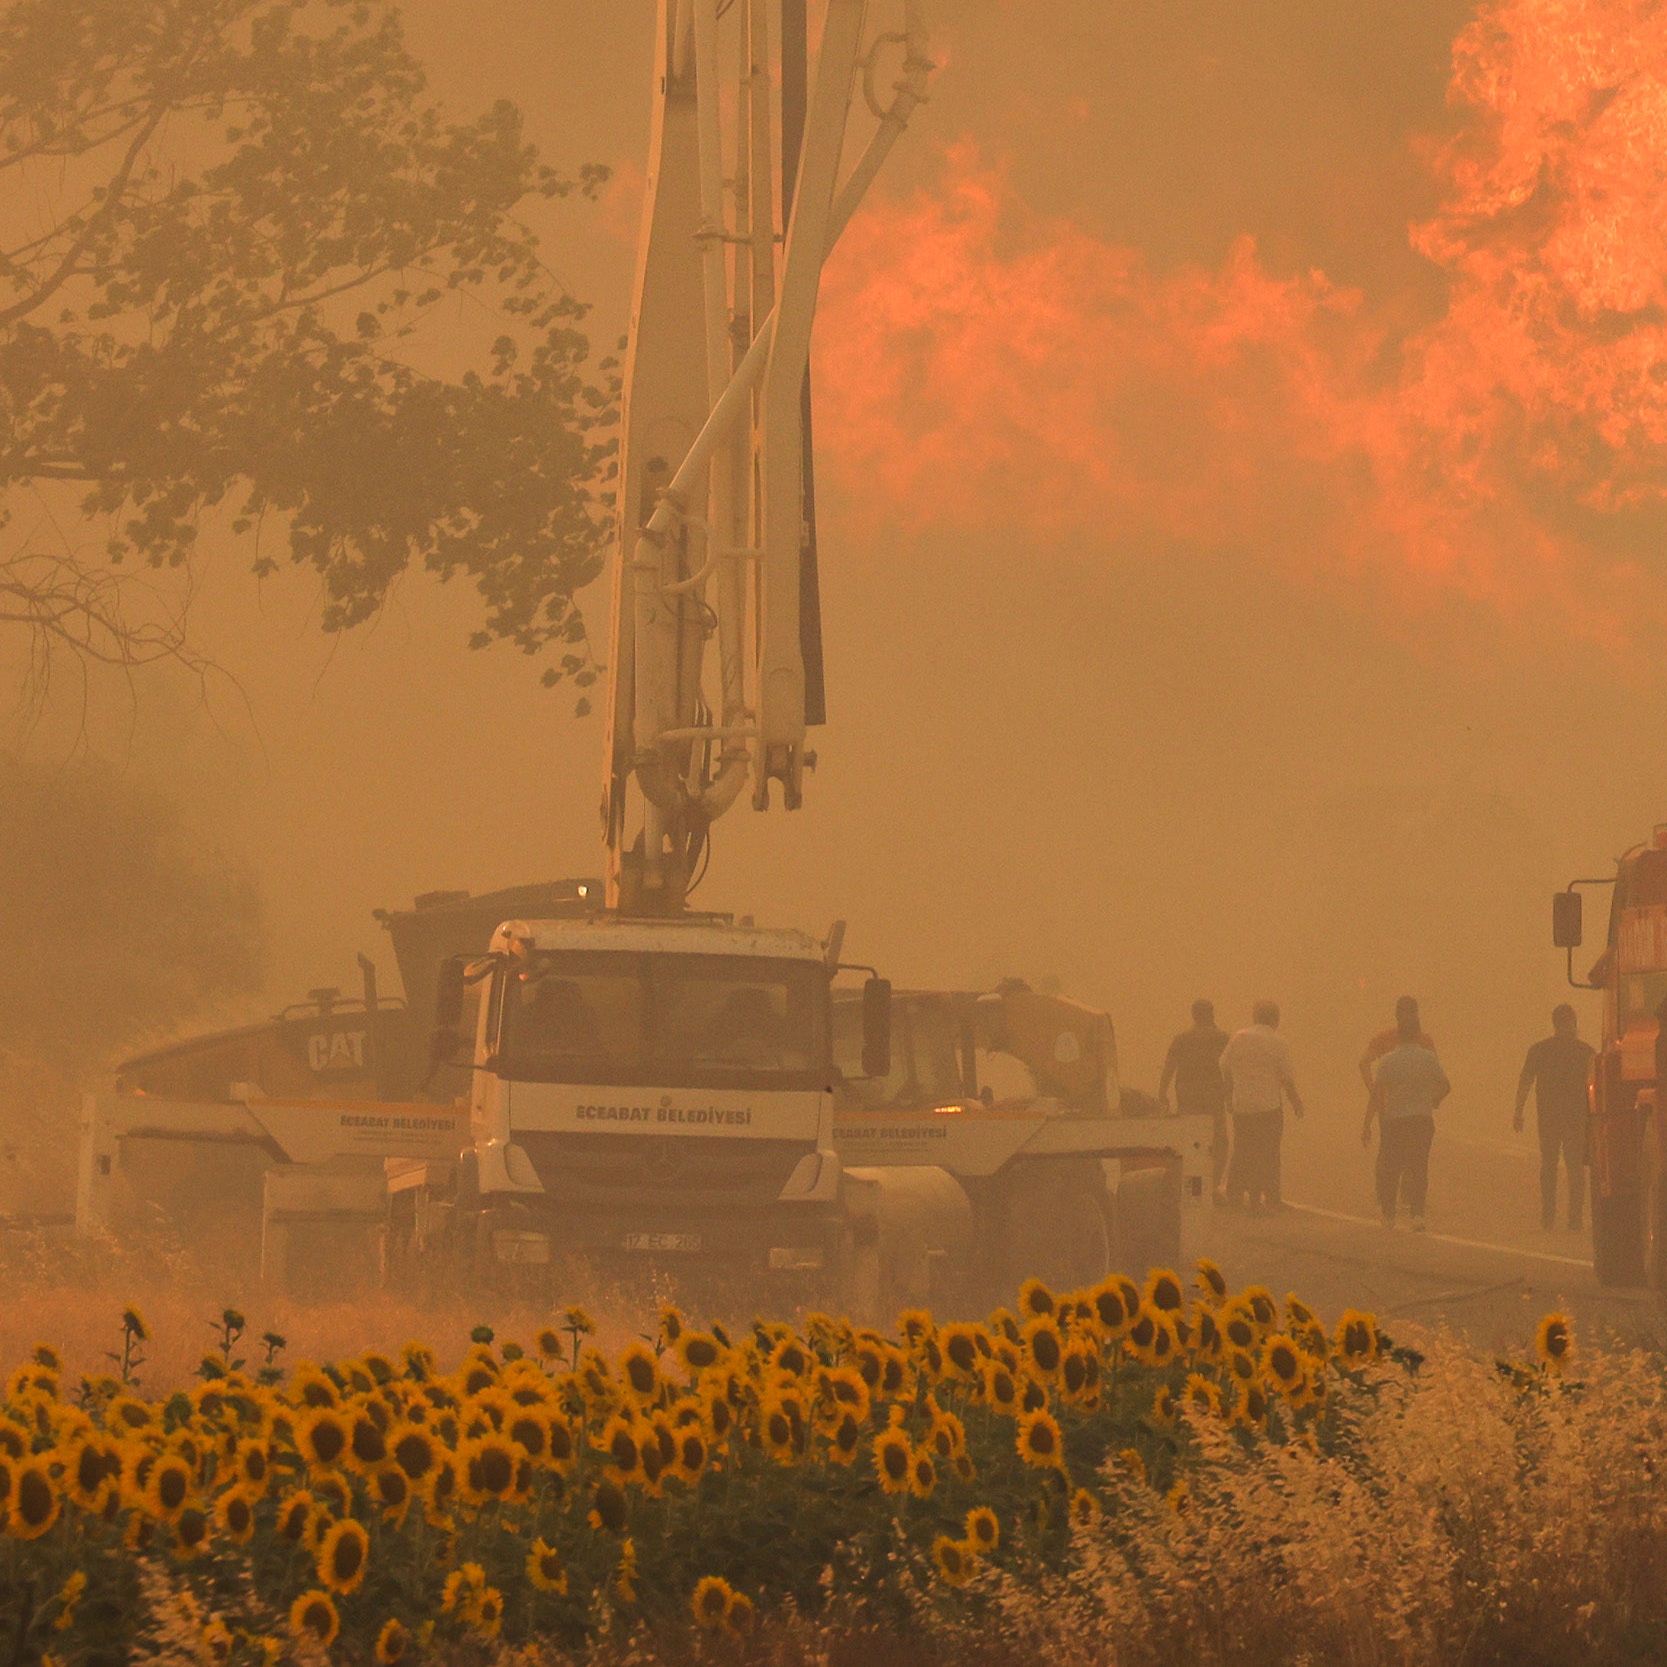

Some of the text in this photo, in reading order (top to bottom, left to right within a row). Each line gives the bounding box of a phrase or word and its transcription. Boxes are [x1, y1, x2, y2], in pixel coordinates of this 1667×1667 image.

[308, 1031, 367, 1071] CAT
[340, 1115, 389, 1128] ECEABAT
[576, 1105, 752, 1125] ECEABAT BELEDİYESİ
[831, 1128, 877, 1140] CEABAT
